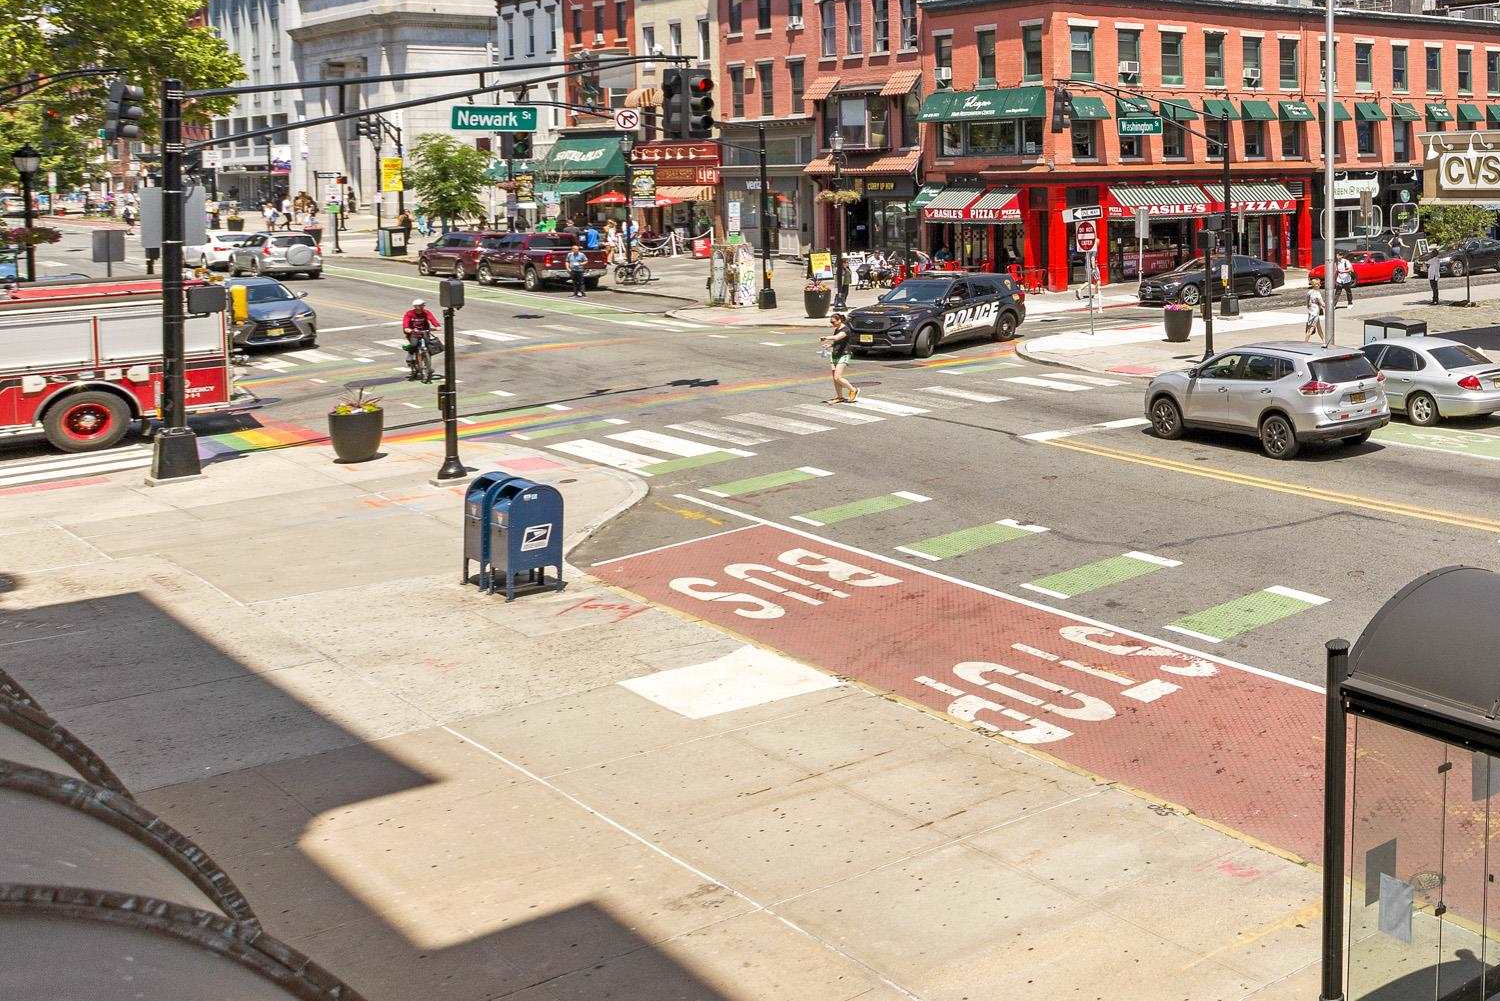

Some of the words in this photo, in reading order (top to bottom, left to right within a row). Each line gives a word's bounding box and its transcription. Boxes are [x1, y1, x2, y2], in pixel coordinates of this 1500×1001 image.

[457, 110, 518, 127] Newark
[522, 111, 531, 120] St
[1121, 121, 1153, 134] Washington
[745, 178, 770, 190] verizn
[1333, 187, 1348, 195] REEN
[934, 209, 963, 218] BASILE'S
[971, 209, 993, 218] PIZZA
[944, 301, 999, 327] POLICE
[668, 546, 903, 620] BUS
[914, 625, 1220, 745] STOP
